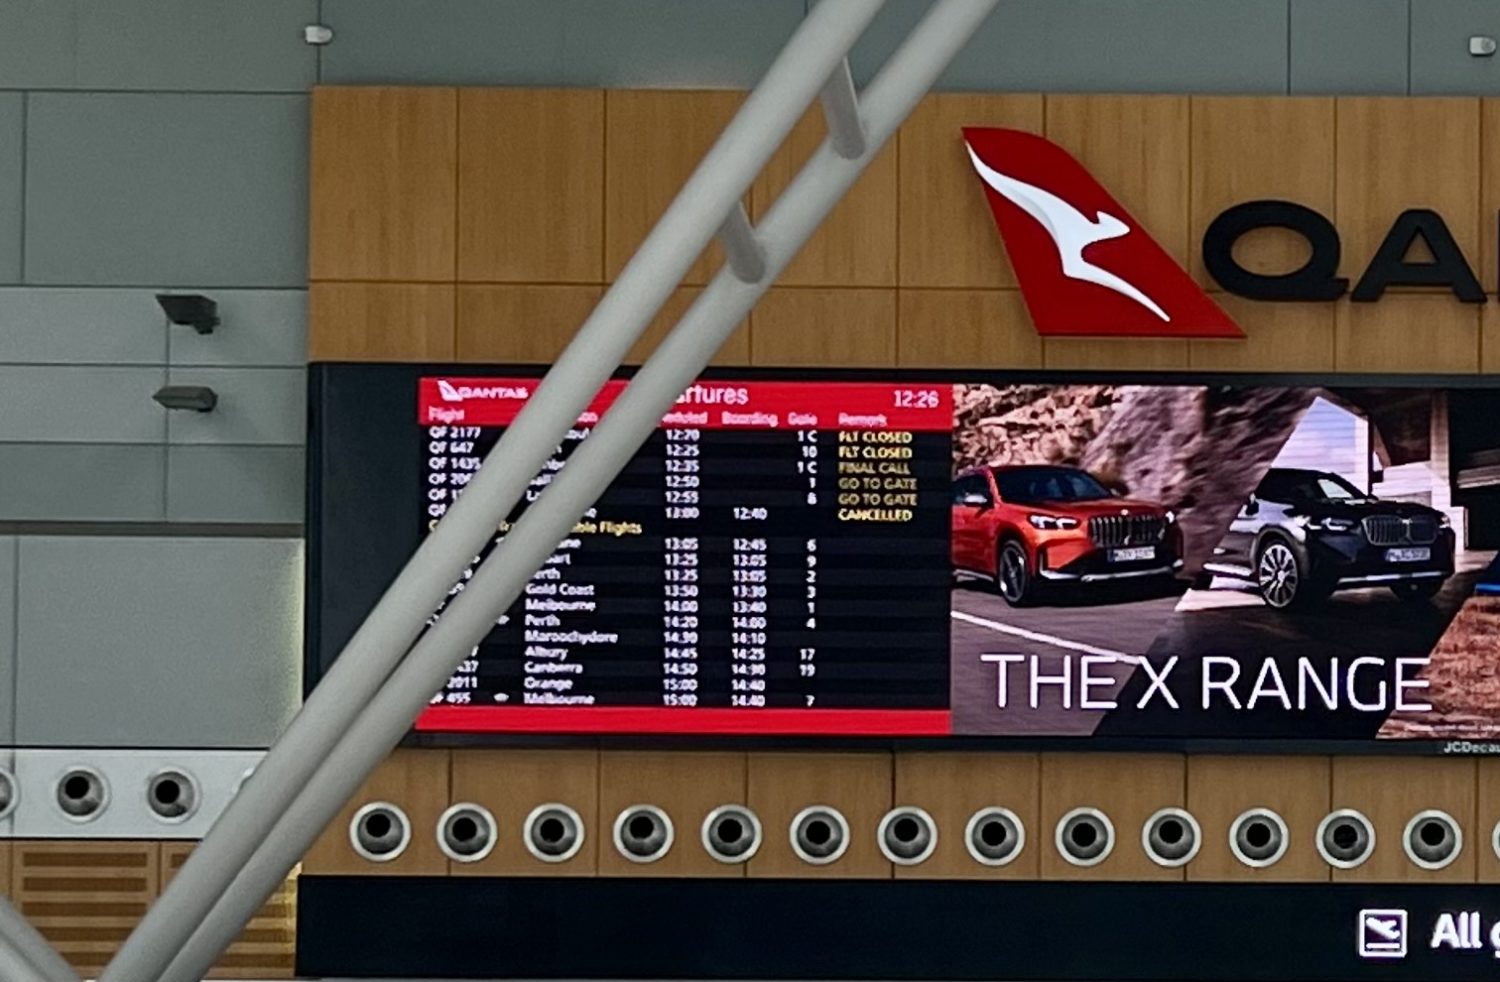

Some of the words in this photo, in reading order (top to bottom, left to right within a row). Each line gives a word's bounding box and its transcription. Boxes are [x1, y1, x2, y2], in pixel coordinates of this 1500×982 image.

[457, 386, 529, 399] QANTAS
[893, 390, 940, 408] 12:26
[838, 431, 858, 444] FLT
[862, 432, 913, 444] CLOSED
[838, 446, 859, 459] FLT
[862, 447, 913, 459] CLOSED
[838, 462, 876, 474] FINAL
[879, 462, 911, 474] CALL
[838, 478, 858, 490] GO
[862, 478, 880, 490] TO
[883, 478, 918, 490] GATE
[838, 493, 858, 506] GO
[862, 493, 880, 506] TO
[883, 493, 918, 506] GATE
[838, 509, 913, 521] CANCELLED
[600, 521, 643, 537] Flights
[525, 583, 557, 596] Gold
[559, 583, 595, 595] Coast
[524, 598, 597, 612] Melbourne
[524, 614, 561, 627] Perth
[524, 629, 619, 645] Maroochydore
[524, 646, 569, 662] Albury
[523, 661, 584, 674] Canberra
[523, 676, 574, 692] Orange
[980, 654, 1118, 711] THE
[1134, 655, 1181, 711] X
[1201, 655, 1433, 713] RANGE
[523, 692, 596, 705] Melbourne
[1431, 912, 1482, 949] All
